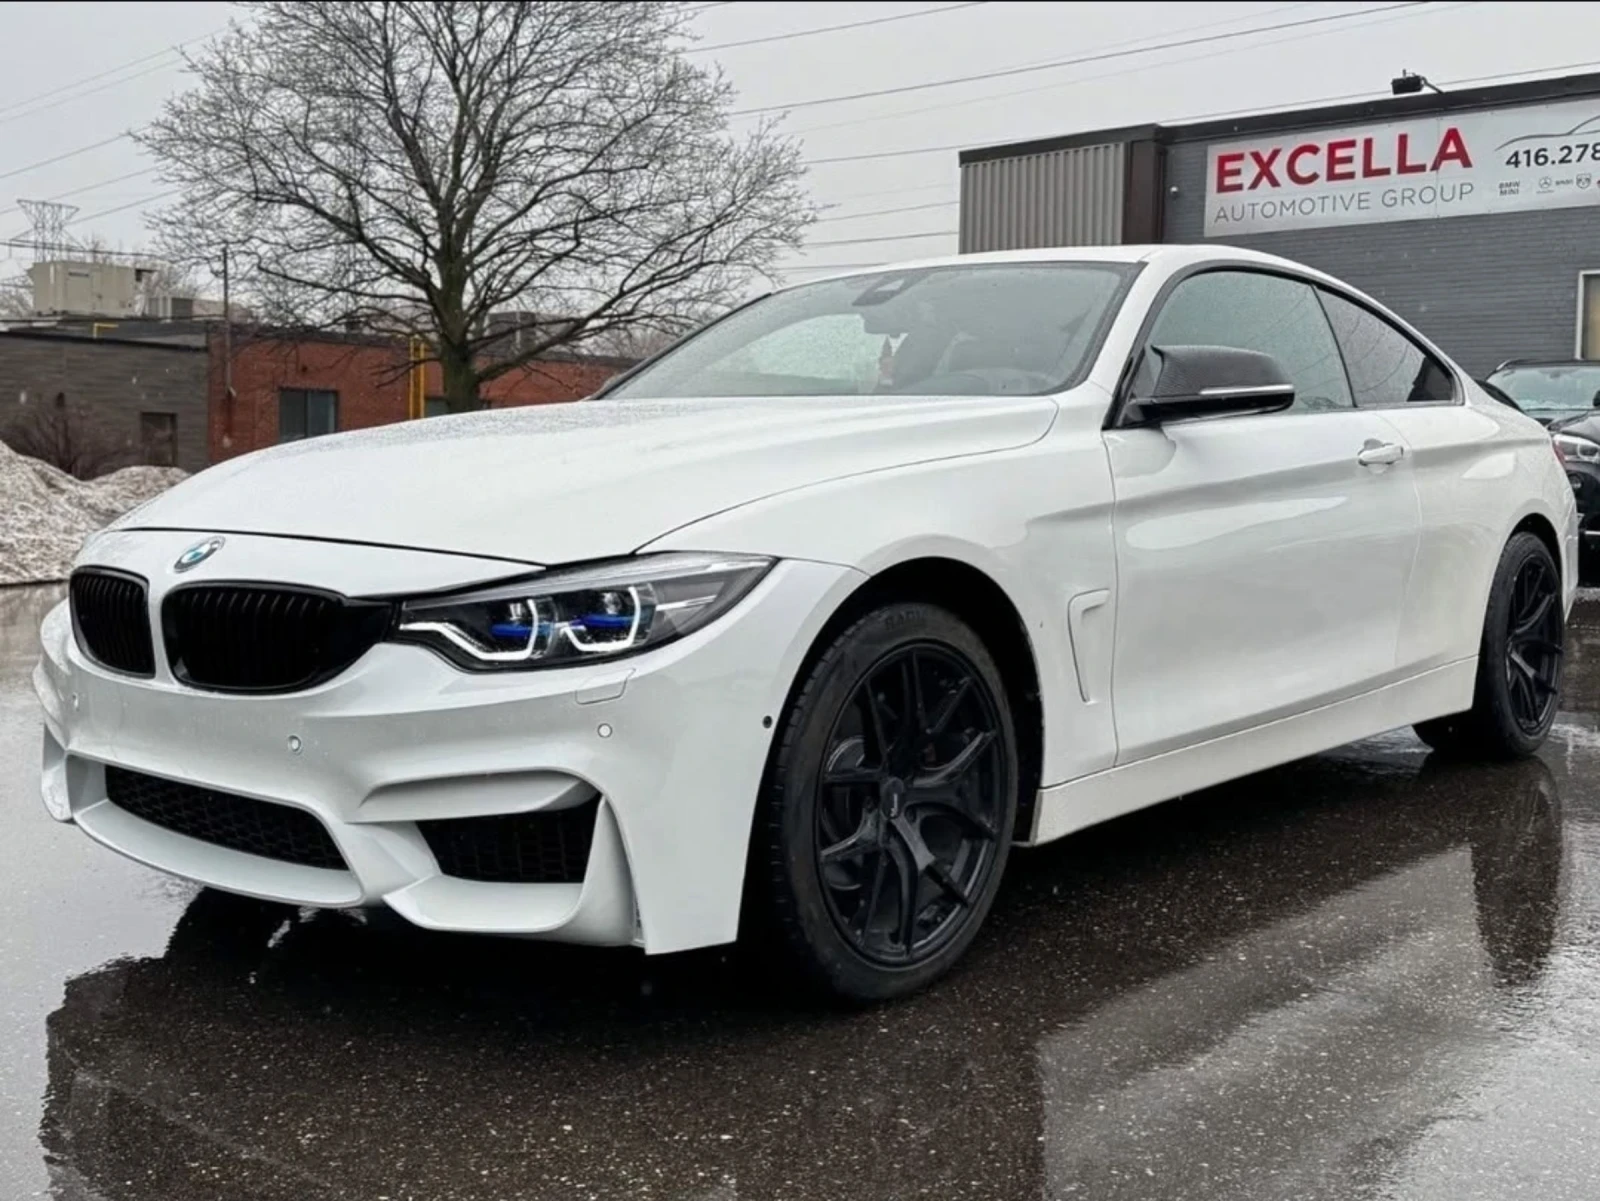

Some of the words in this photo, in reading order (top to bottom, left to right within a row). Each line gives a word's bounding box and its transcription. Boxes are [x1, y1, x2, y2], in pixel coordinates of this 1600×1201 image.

[1216, 128, 1472, 193] EXCELLA
[1506, 142, 1600, 168] 416.278
[1214, 194, 1371, 224] AUTOMOTIVE
[1382, 183, 1474, 208] GROUP
